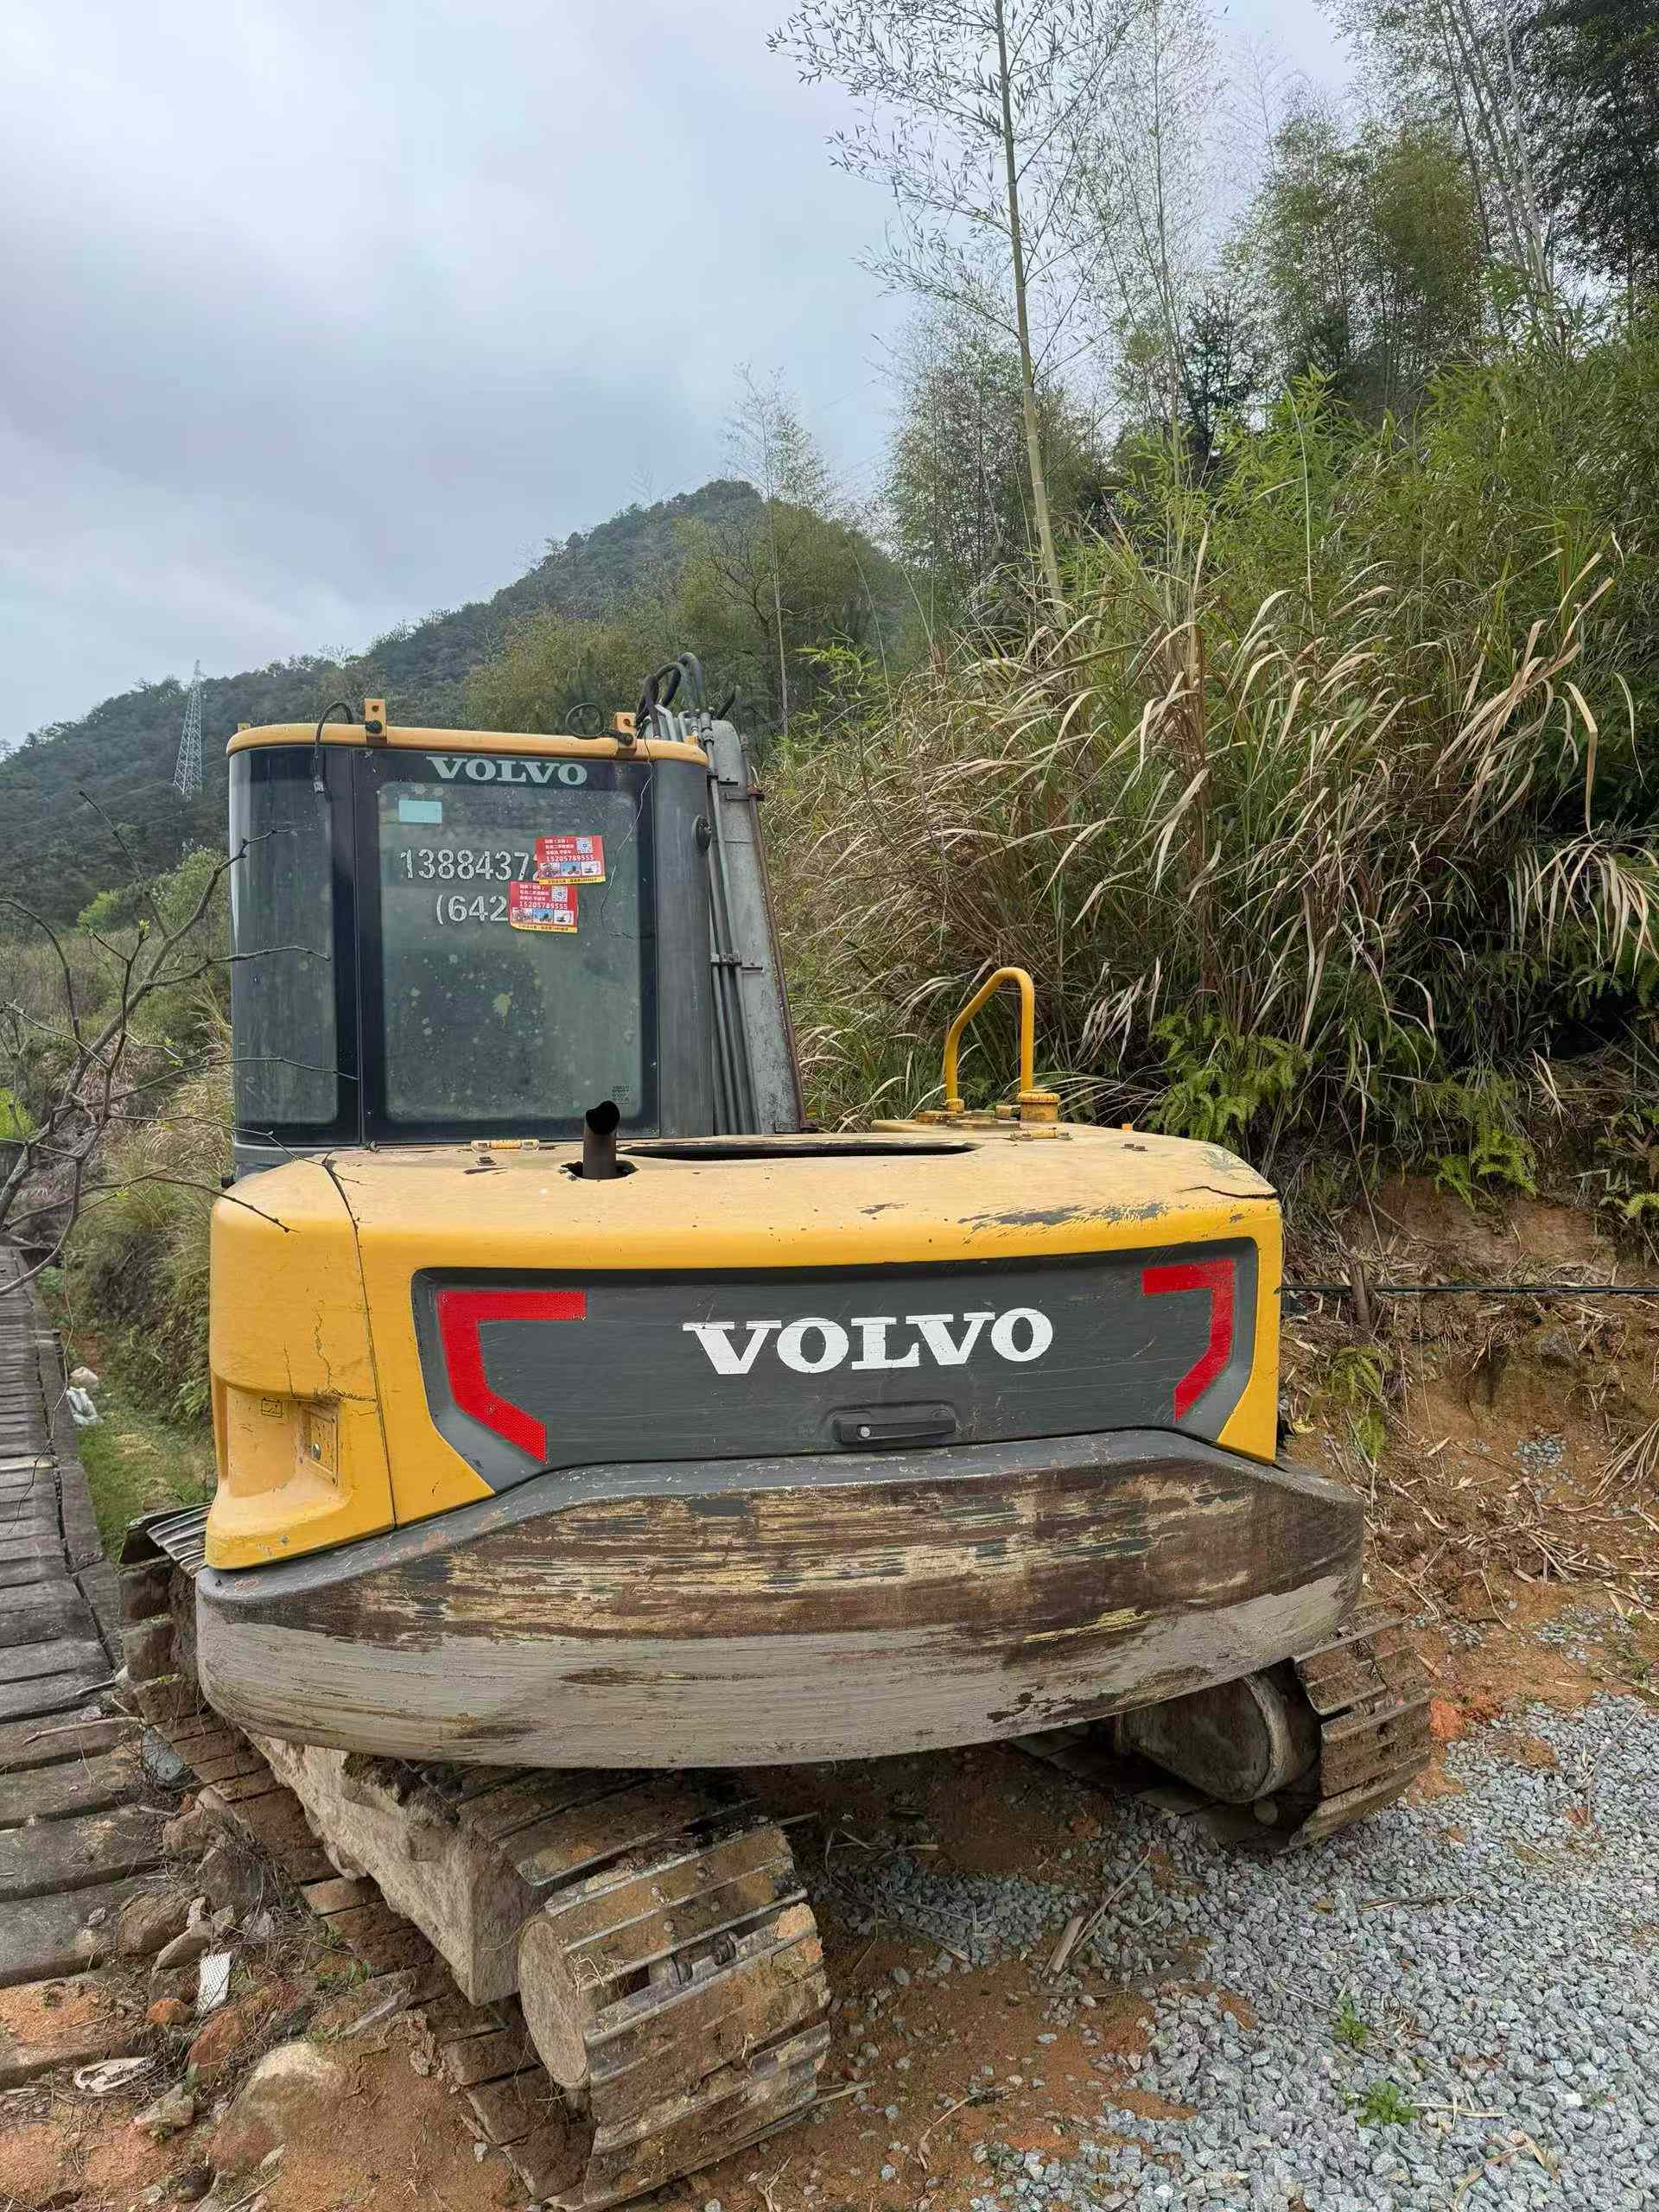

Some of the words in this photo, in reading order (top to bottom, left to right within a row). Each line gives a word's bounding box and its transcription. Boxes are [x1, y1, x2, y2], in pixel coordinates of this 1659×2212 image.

[426, 755, 588, 785] VOLVO
[400, 849, 537, 881] 1388437
[682, 1307, 1053, 1375] VOLVO
